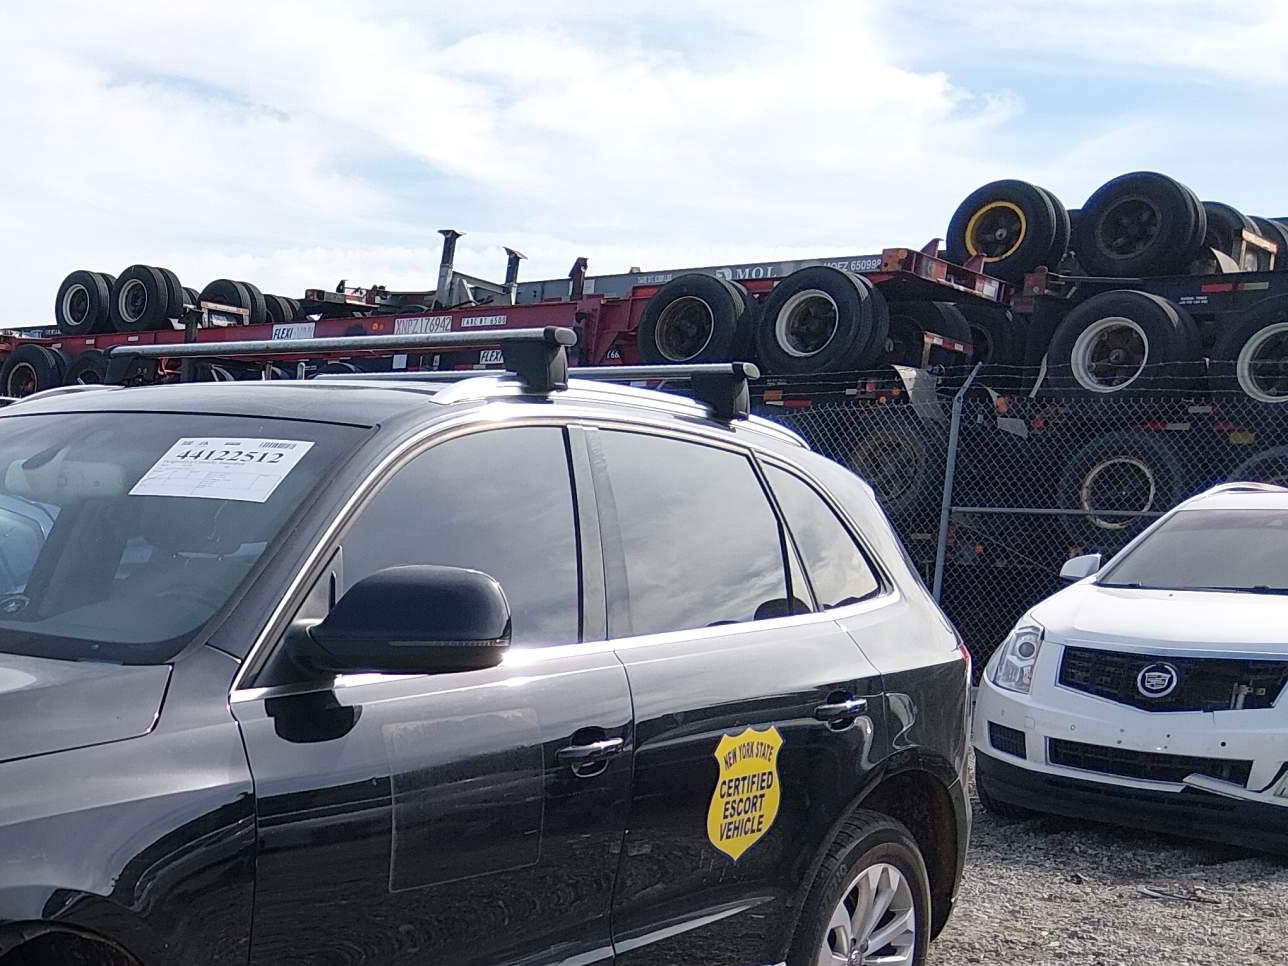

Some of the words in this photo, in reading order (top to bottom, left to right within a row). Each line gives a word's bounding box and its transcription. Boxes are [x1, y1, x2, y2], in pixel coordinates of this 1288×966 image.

[736, 266, 777, 280] MOL
[176, 448, 284, 464] 44122512
[723, 749, 737, 770] NEW
[738, 741, 754, 762] YORK
[755, 741, 774, 763] STATE
[719, 770, 774, 799] CERTIFIED
[722, 793, 766, 820] ESCORT
[719, 814, 764, 841] VEHICLE
